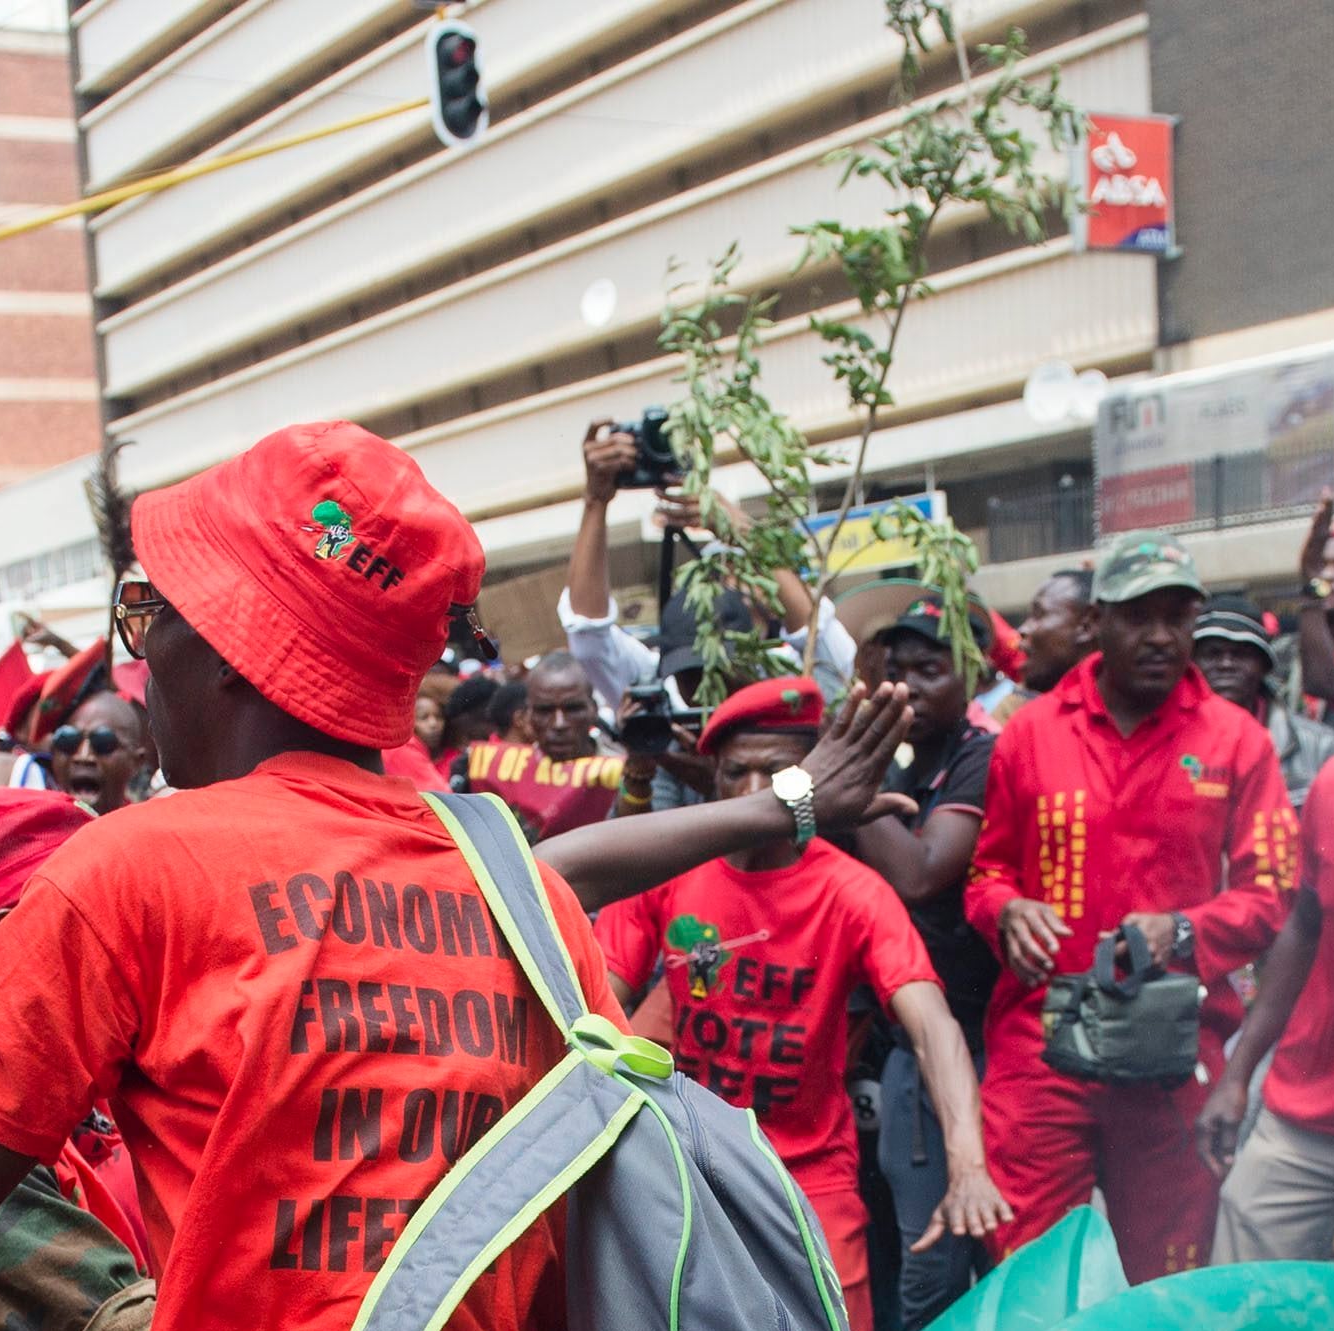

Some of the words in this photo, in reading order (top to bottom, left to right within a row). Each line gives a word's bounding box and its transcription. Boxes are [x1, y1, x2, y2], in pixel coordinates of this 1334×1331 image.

[346, 542, 406, 592] EFF
[497, 746, 534, 782] OF
[733, 956, 816, 1004] EFF
[290, 977, 528, 1067] FREEDOM
[312, 1087, 382, 1163] IN
